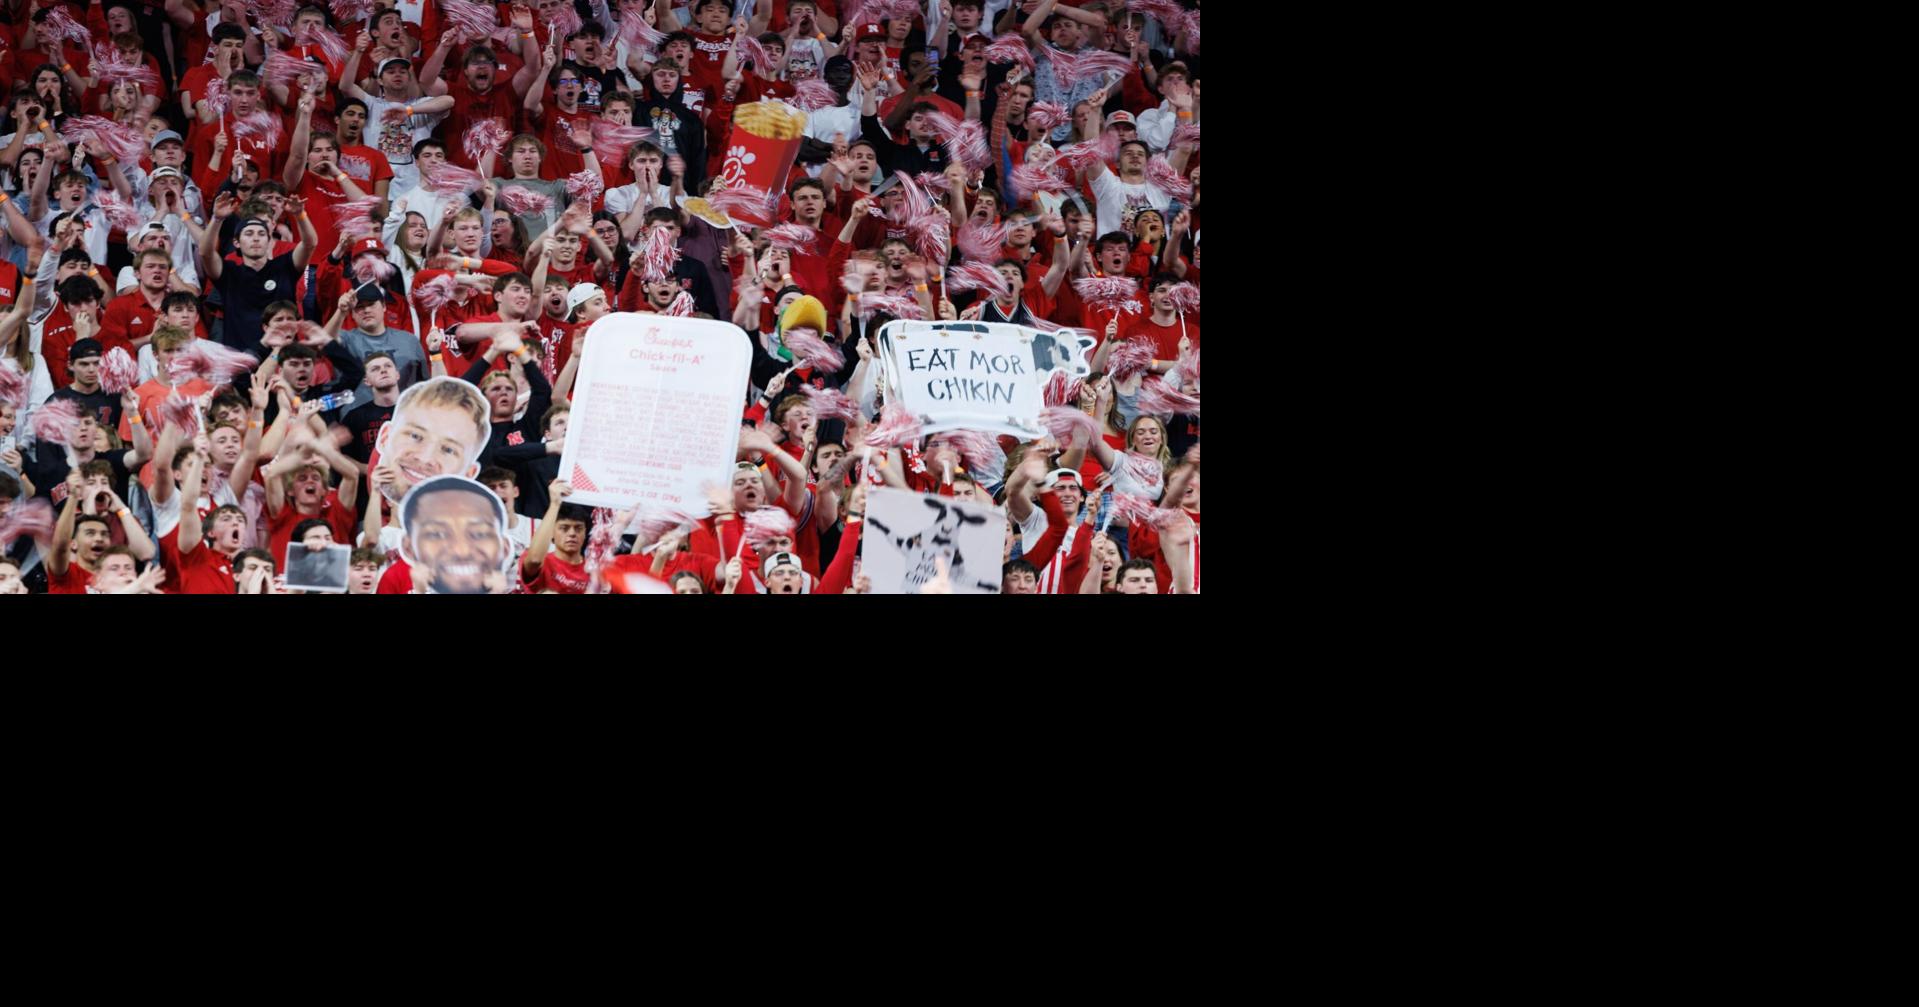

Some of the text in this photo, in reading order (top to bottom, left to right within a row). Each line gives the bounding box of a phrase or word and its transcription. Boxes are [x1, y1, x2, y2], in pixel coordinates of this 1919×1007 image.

[365, 239, 378, 248] N
[907, 347, 1026, 375] EAT MOR
[927, 376, 1016, 404] CHIKIN
[506, 430, 525, 447] N
